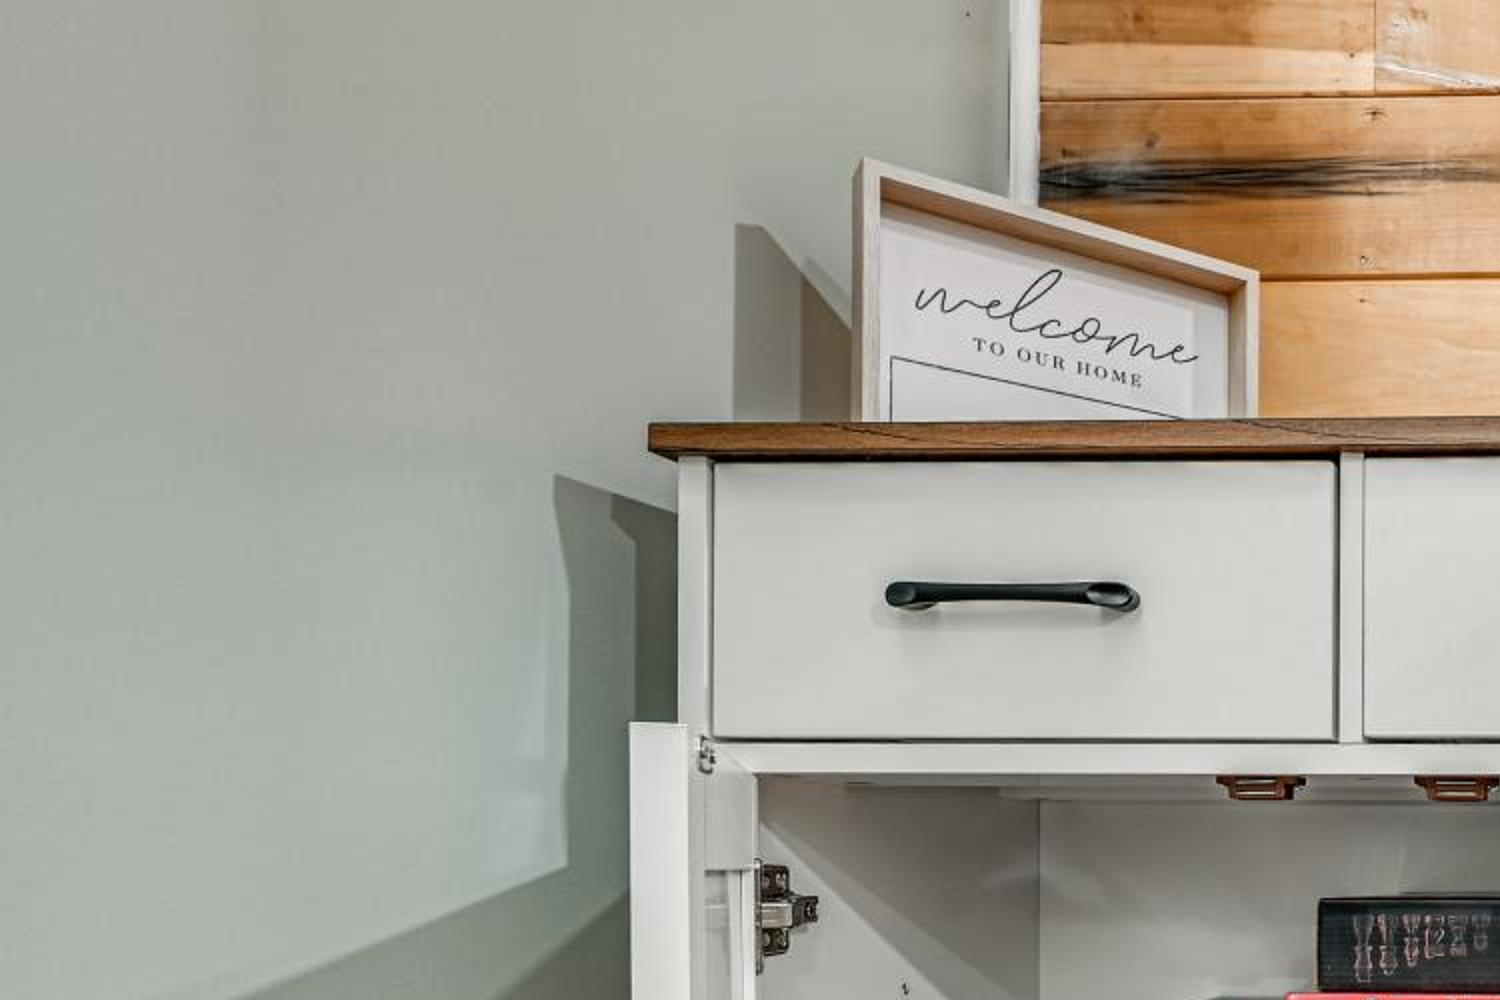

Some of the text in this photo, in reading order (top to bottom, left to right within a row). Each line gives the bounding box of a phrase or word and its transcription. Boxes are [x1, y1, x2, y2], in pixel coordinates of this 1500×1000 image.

[914, 269, 1199, 364] welcome
[973, 336, 1143, 388] TO OUR HOME
